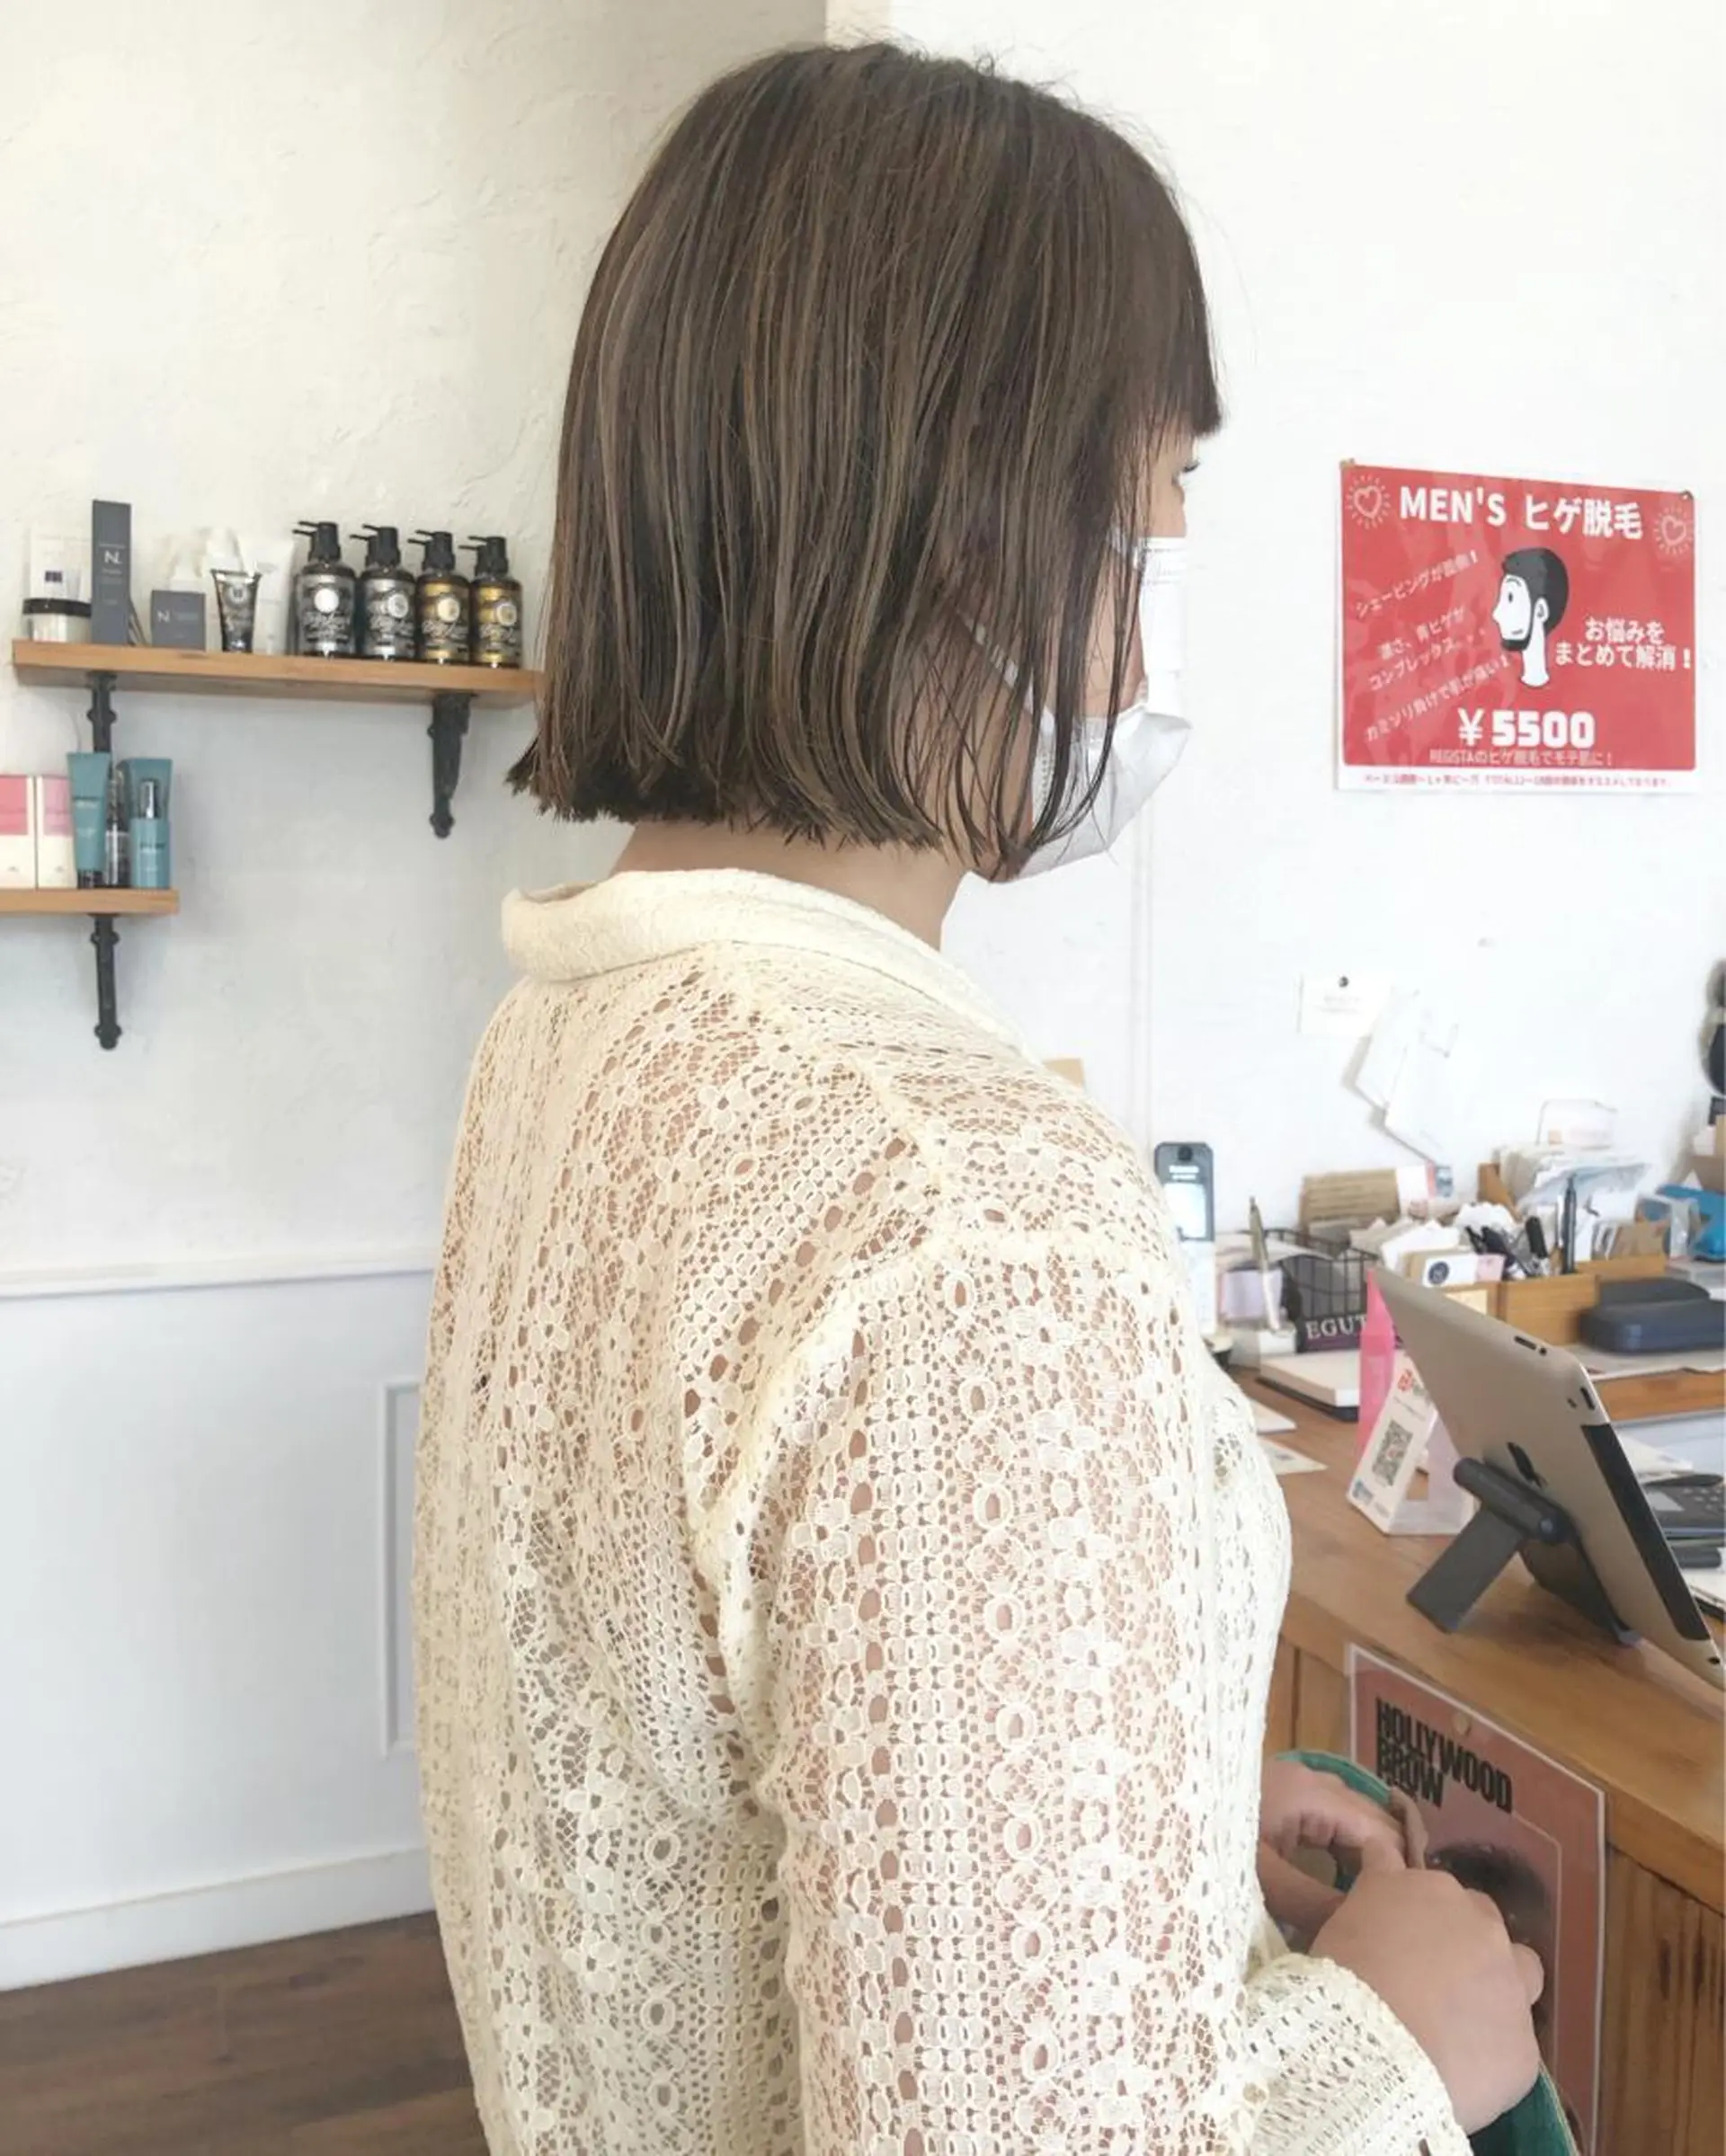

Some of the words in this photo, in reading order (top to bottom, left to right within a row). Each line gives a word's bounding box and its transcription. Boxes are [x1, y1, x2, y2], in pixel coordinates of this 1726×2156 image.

[1400, 486, 1507, 527] MEN'S
[1525, 494, 1643, 539] ヒゲ脱毛
[1555, 640, 1691, 671] まとめて解消！
[1585, 617, 1665, 645] お悩みを
[1375, 1696, 1513, 1814] HOLLYWOOD
[1376, 1736, 1444, 1808] BROW
